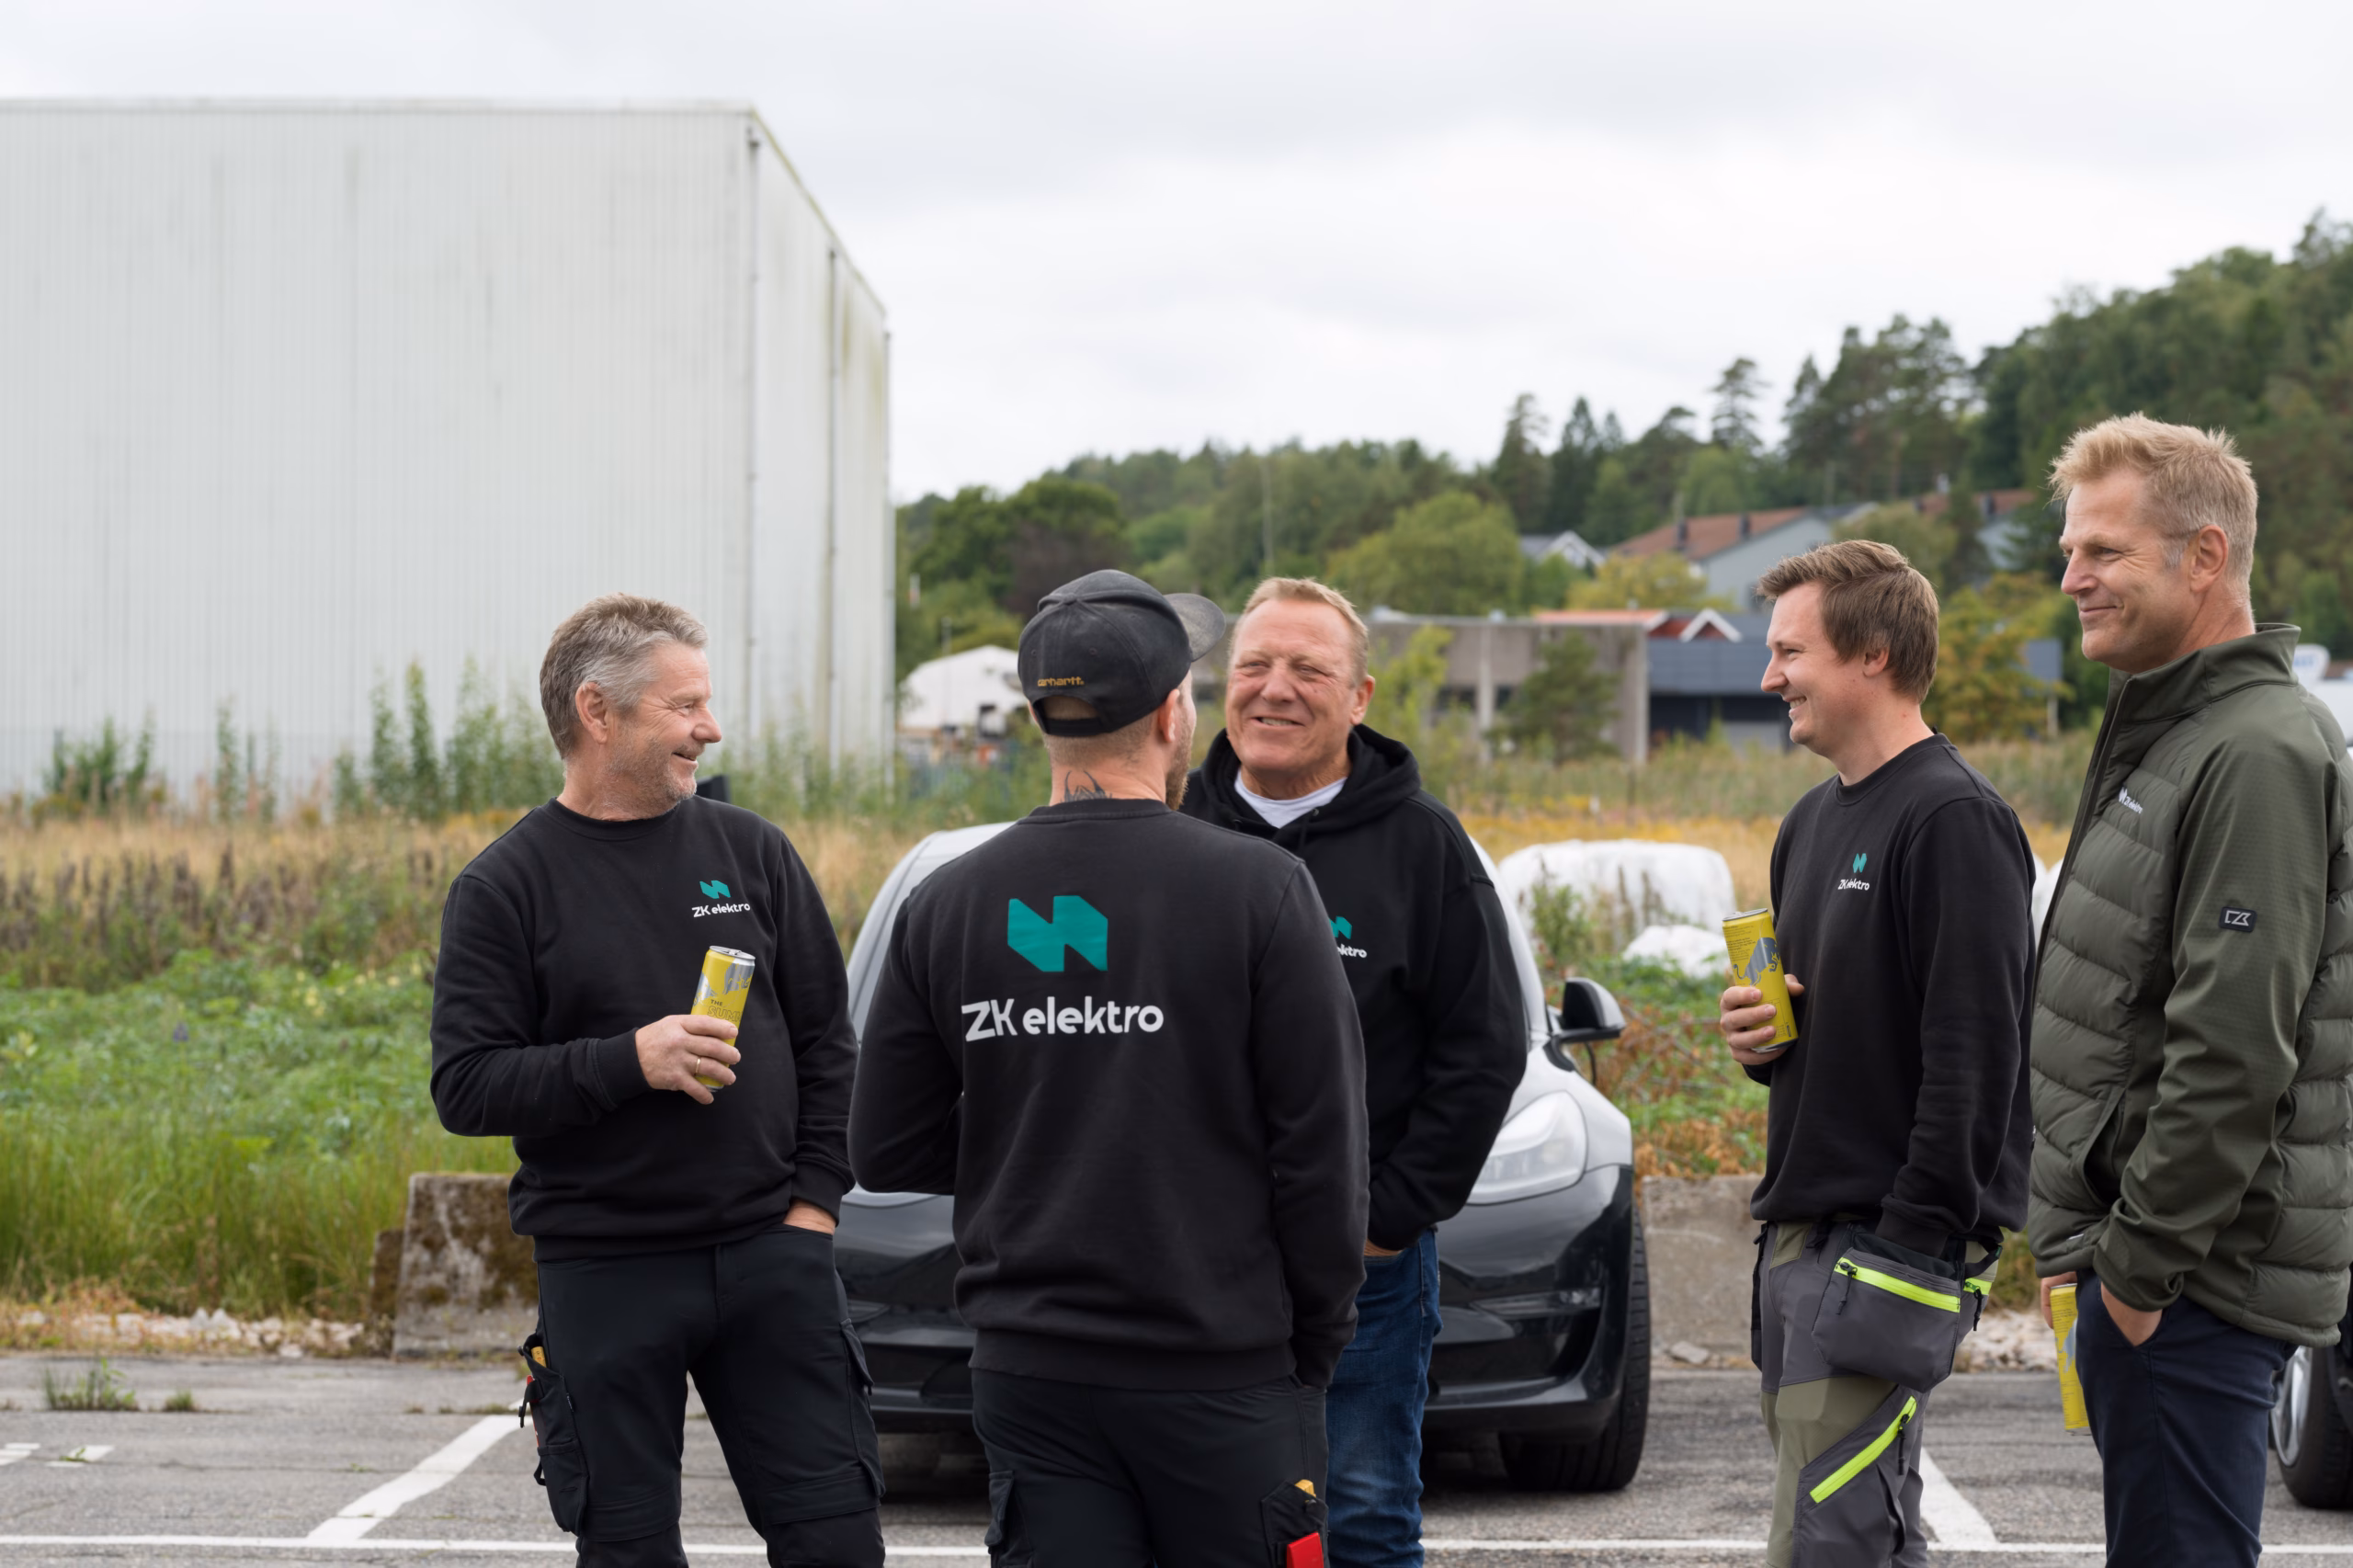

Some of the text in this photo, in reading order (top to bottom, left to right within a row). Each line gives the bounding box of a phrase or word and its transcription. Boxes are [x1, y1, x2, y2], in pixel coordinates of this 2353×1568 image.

[691, 903, 751, 918] ZK elektro
[1337, 943, 1368, 959] ktro
[710, 998, 723, 1006] THE
[707, 1005, 741, 1022] SUM
[961, 995, 1165, 1041] ZK elektro
